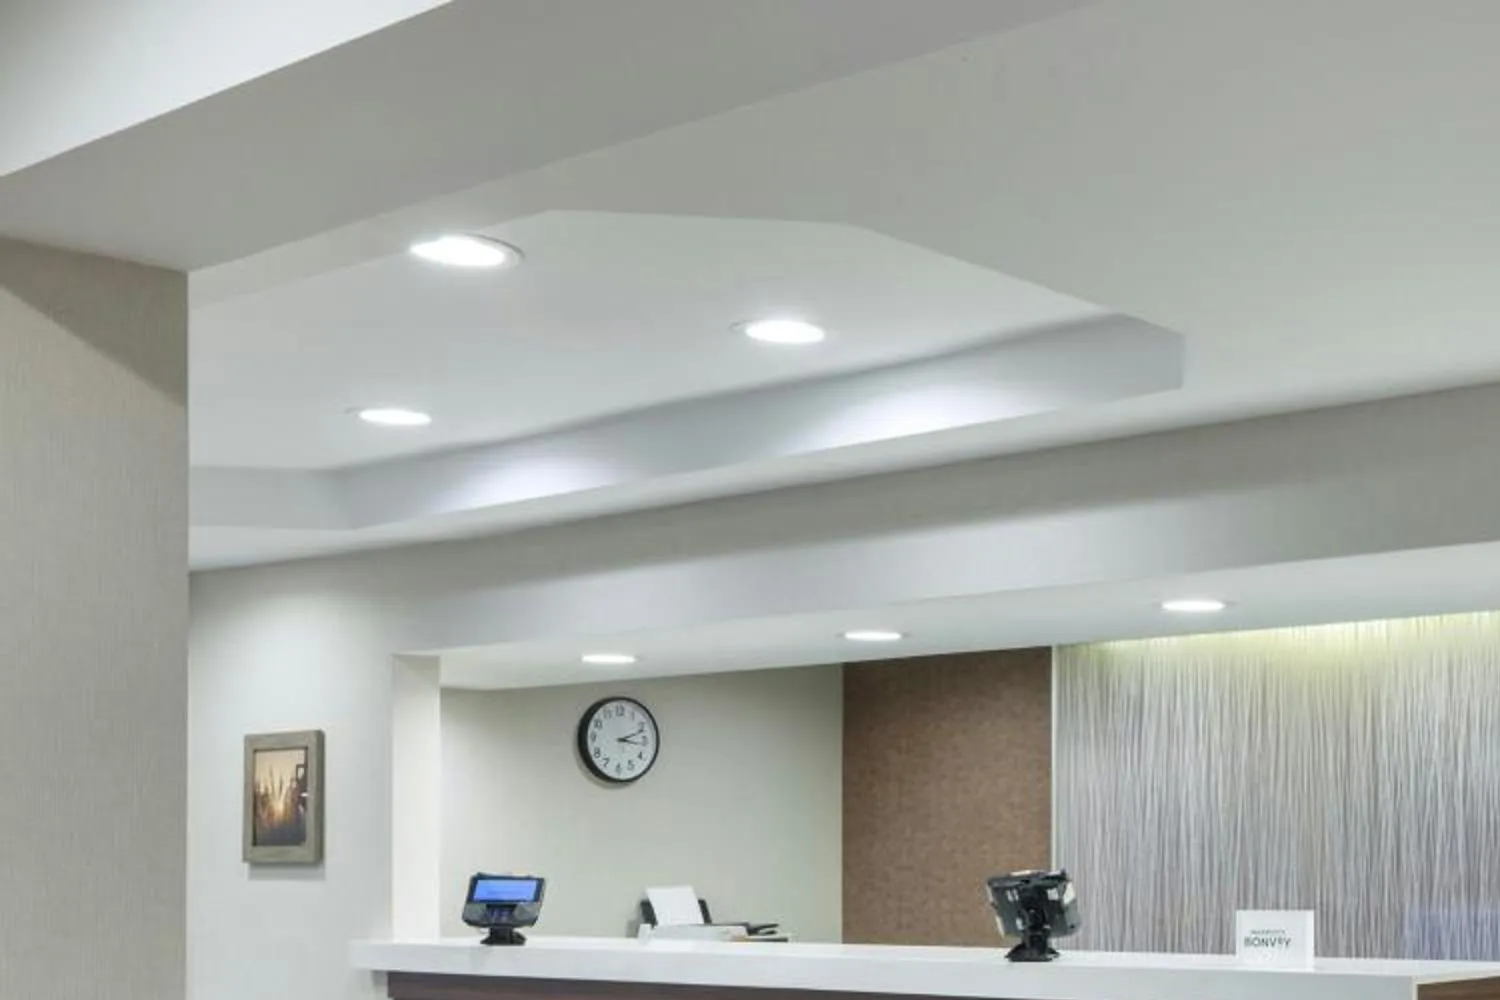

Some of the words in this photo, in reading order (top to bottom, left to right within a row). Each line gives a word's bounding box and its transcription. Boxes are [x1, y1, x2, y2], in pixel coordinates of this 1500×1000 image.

[615, 705, 625, 717] 12
[593, 747, 601, 758] 8
[602, 757, 610, 768] 7
[627, 759, 635, 771] 5
